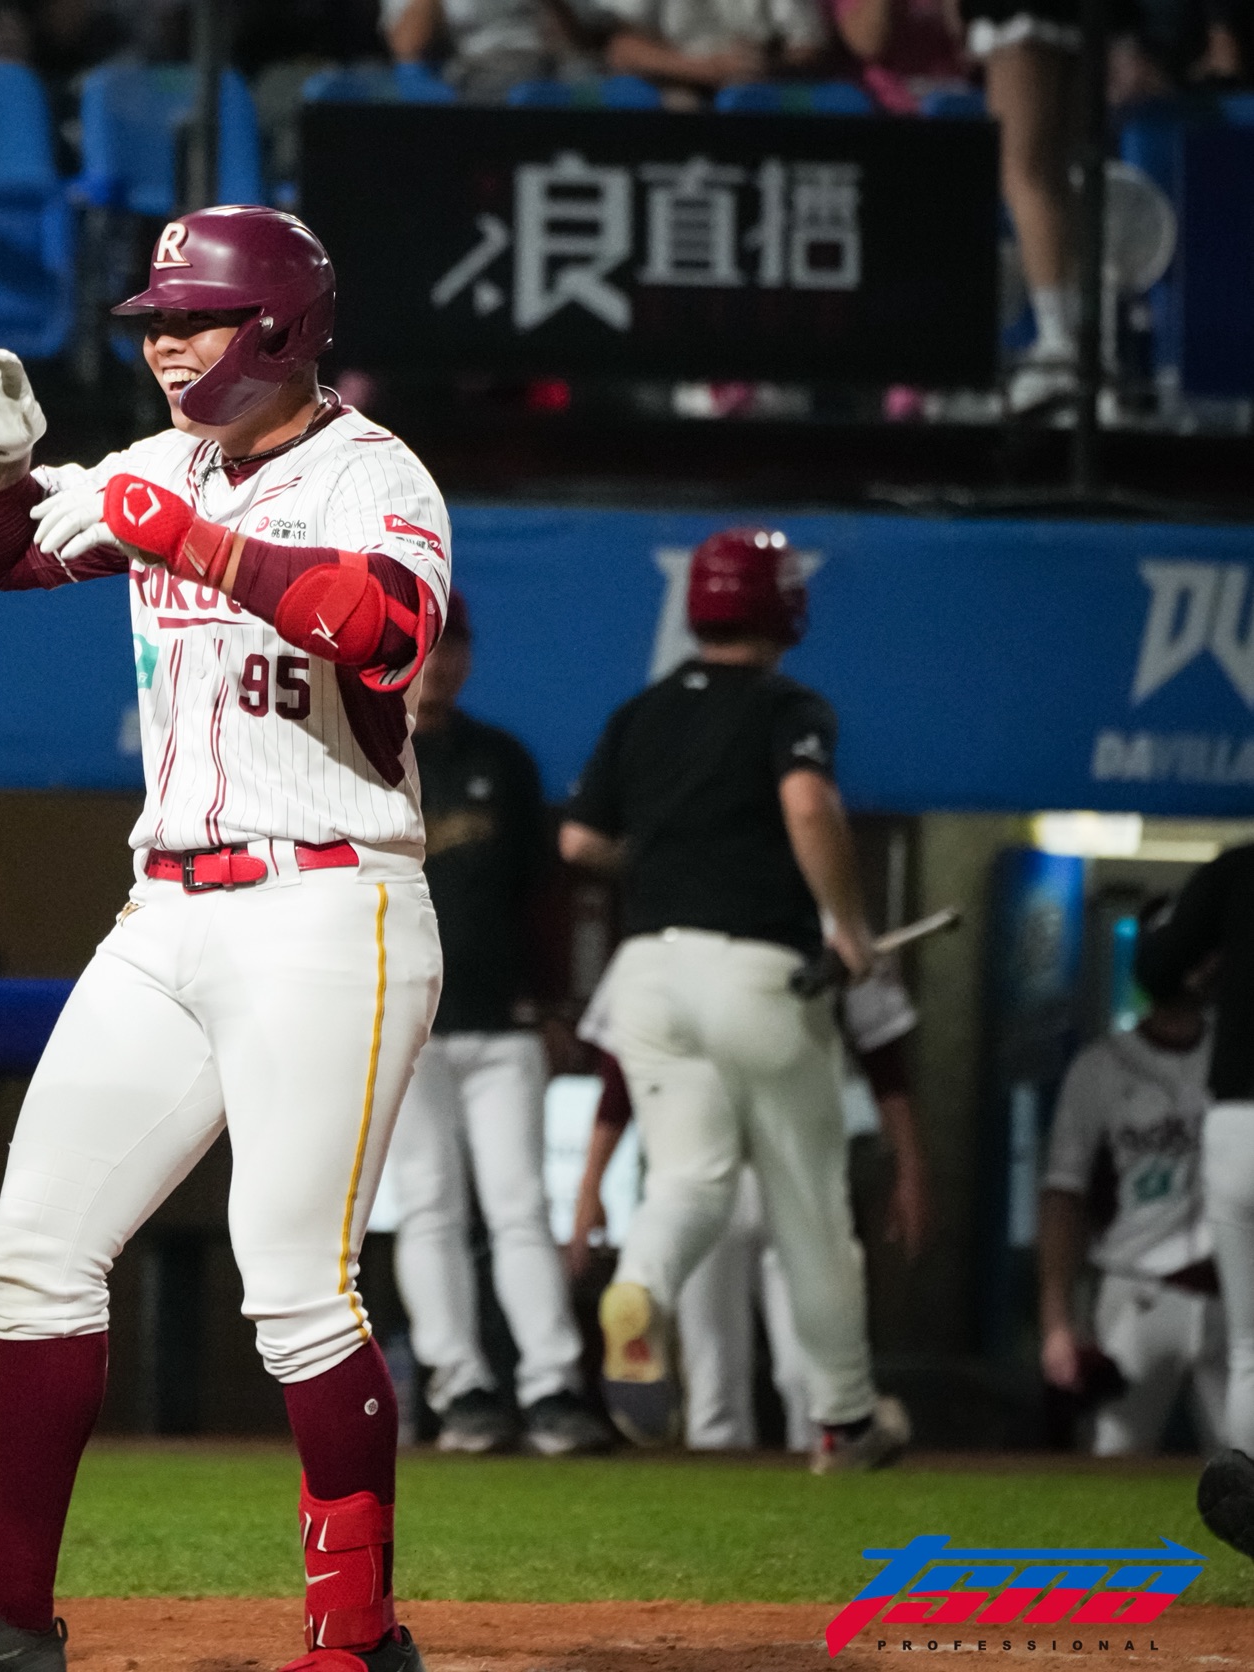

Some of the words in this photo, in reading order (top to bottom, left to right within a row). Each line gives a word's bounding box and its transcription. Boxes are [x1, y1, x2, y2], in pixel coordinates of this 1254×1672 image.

[154, 222, 190, 267] R
[431, 150, 862, 333] 浪直播
[238, 653, 311, 720] 95
